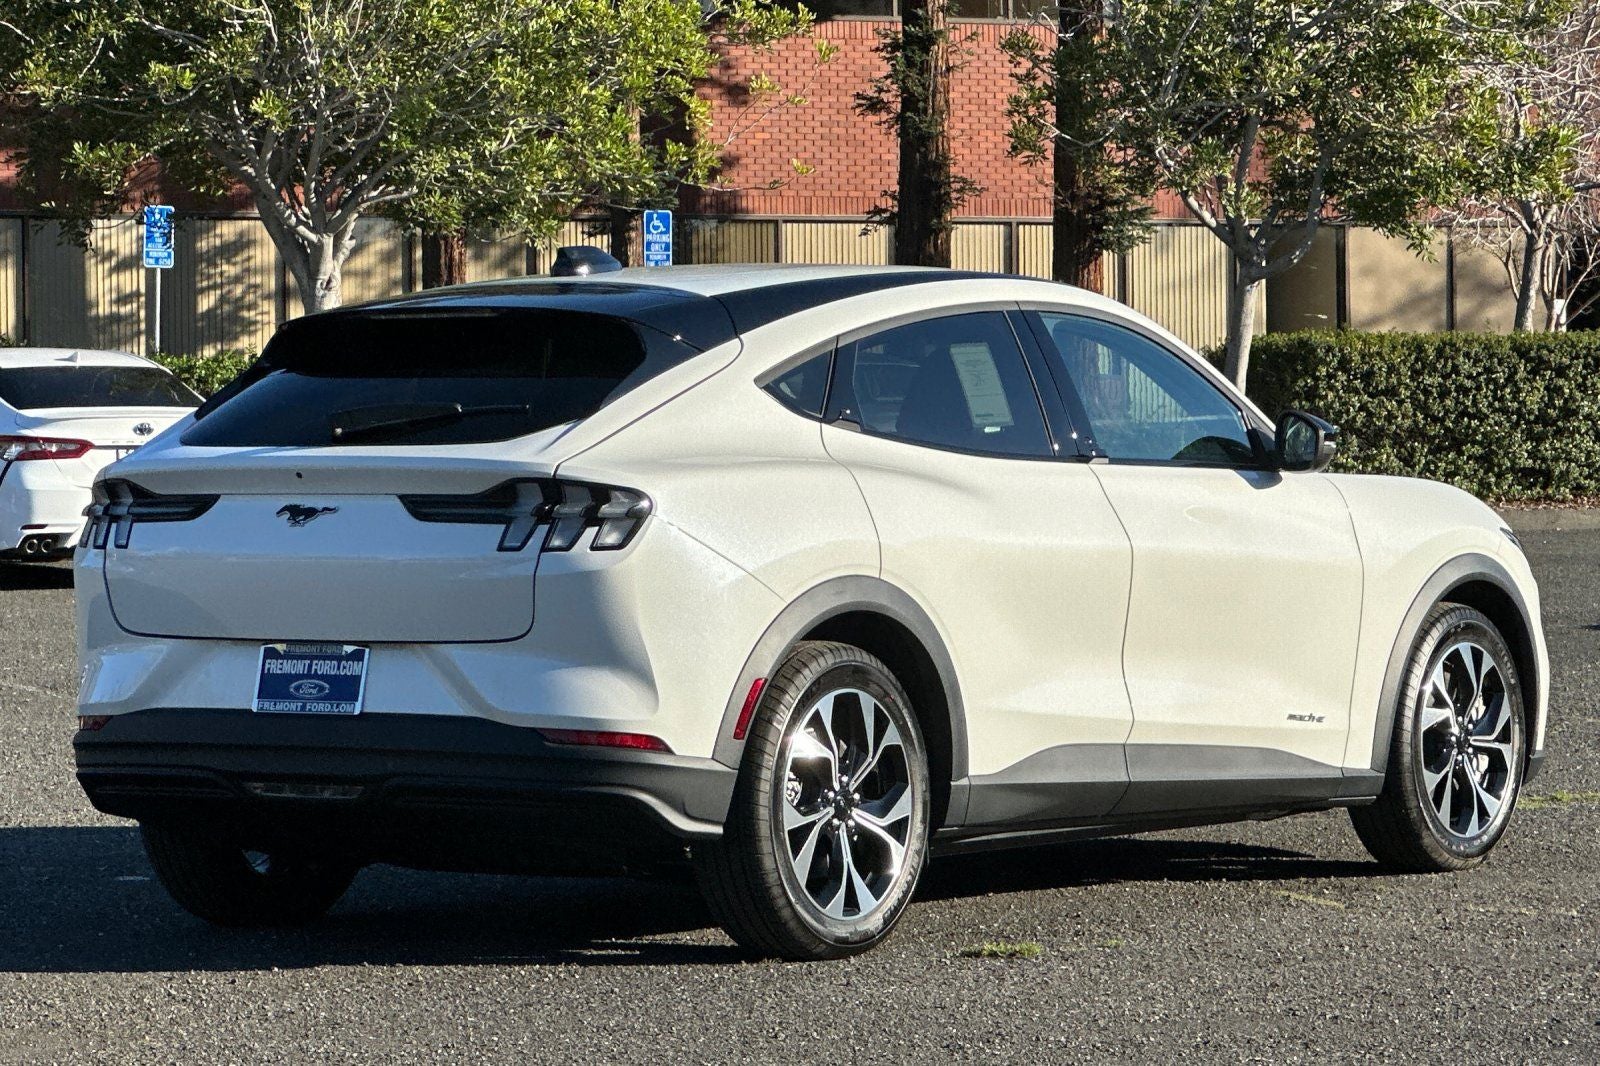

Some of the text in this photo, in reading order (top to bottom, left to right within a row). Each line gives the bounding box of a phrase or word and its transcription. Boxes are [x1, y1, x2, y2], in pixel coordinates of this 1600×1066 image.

[646, 233, 670, 242] PARKING
[650, 243, 665, 252] ONLY
[286, 643, 321, 653] FREMONT
[264, 659, 363, 676] FREMONT FORD.COM
[299, 683, 319, 695] Ford
[258, 701, 355, 713] FREMONT FORD.COM
